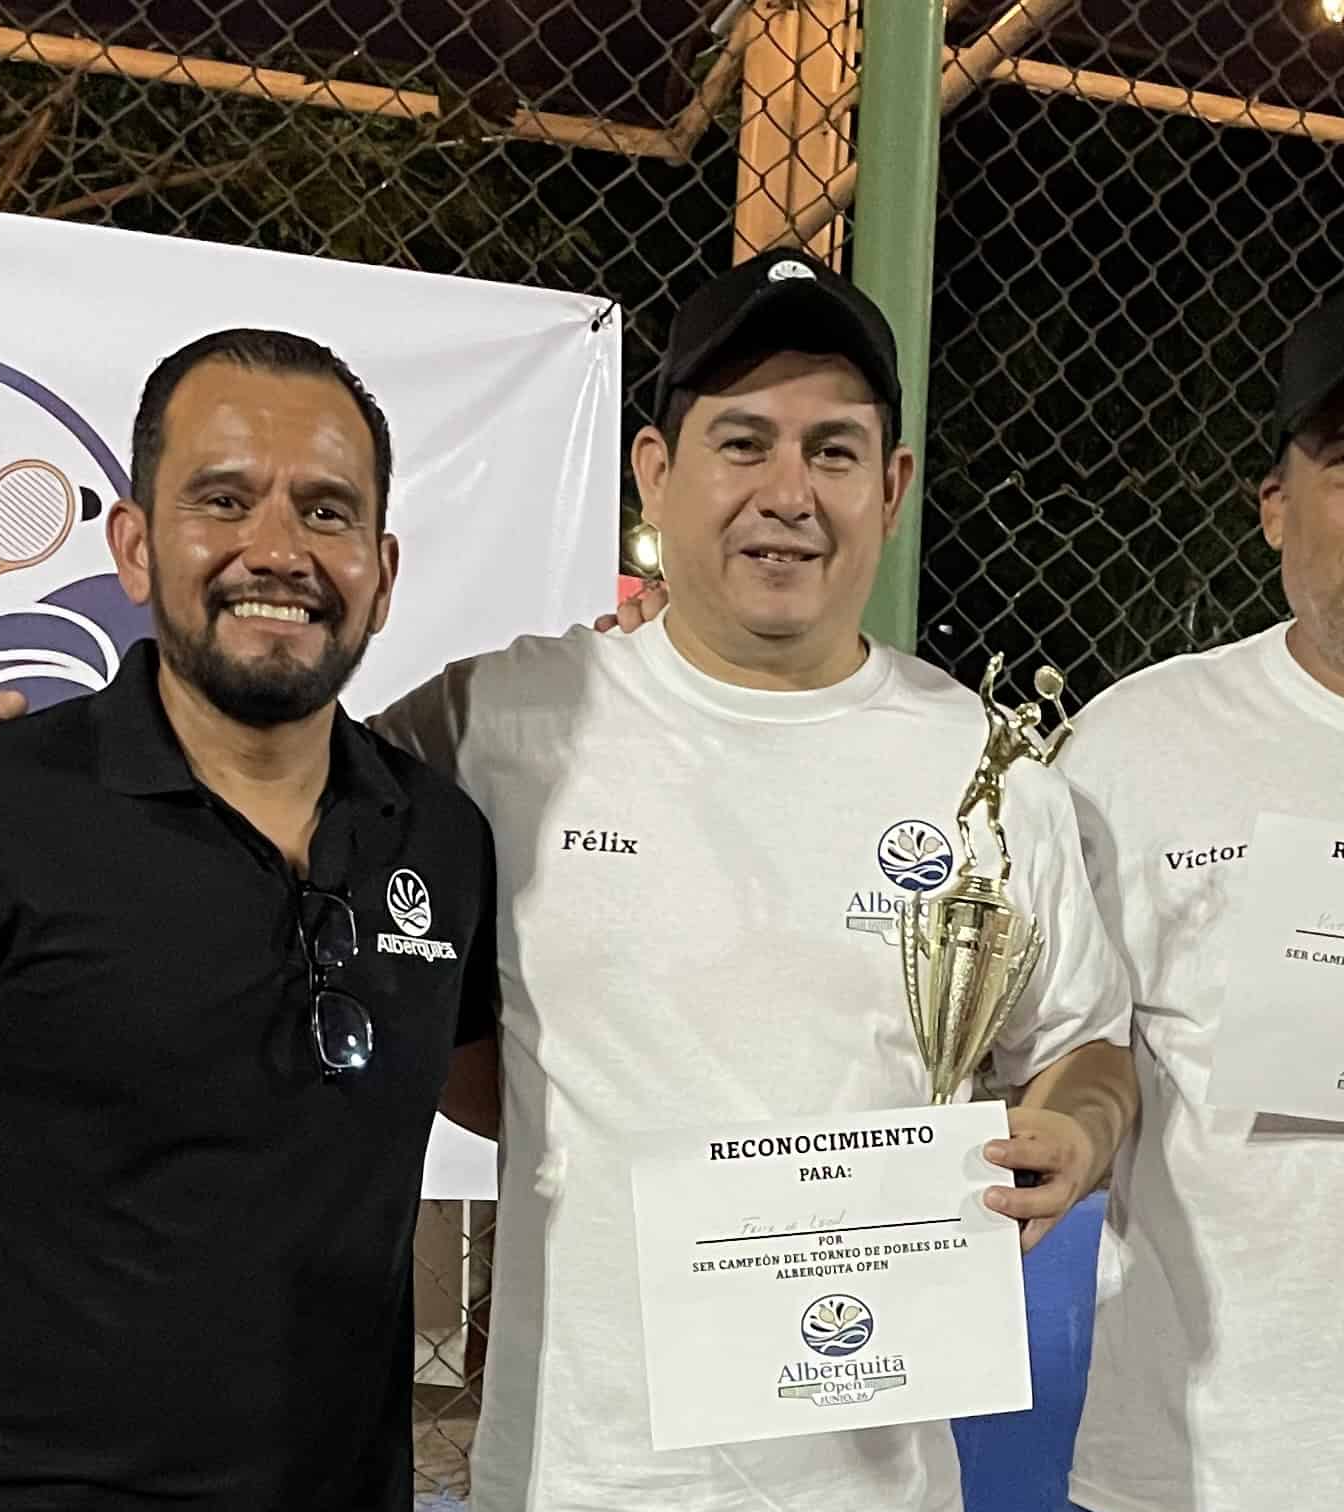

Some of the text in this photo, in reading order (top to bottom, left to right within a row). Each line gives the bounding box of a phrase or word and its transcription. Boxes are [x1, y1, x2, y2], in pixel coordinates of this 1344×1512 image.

[560, 829, 638, 855] Félix
[1285, 948, 1309, 960] SER
[710, 1125, 935, 1160] RECONOCIMIENTO
[799, 1165, 853, 1182] PARA:
[818, 1235, 844, 1246] POR
[692, 1261, 716, 1272] SER
[784, 1252, 808, 1264] DEL
[810, 1247, 861, 1262] TORNEO
[864, 1246, 881, 1257] DE
[884, 1241, 931, 1255] DOBLES
[934, 1239, 950, 1250] DE
[953, 1238, 968, 1249] LA
[776, 1259, 889, 1280] ALBERQUITA OPEN
[823, 1380, 863, 1396] Open
